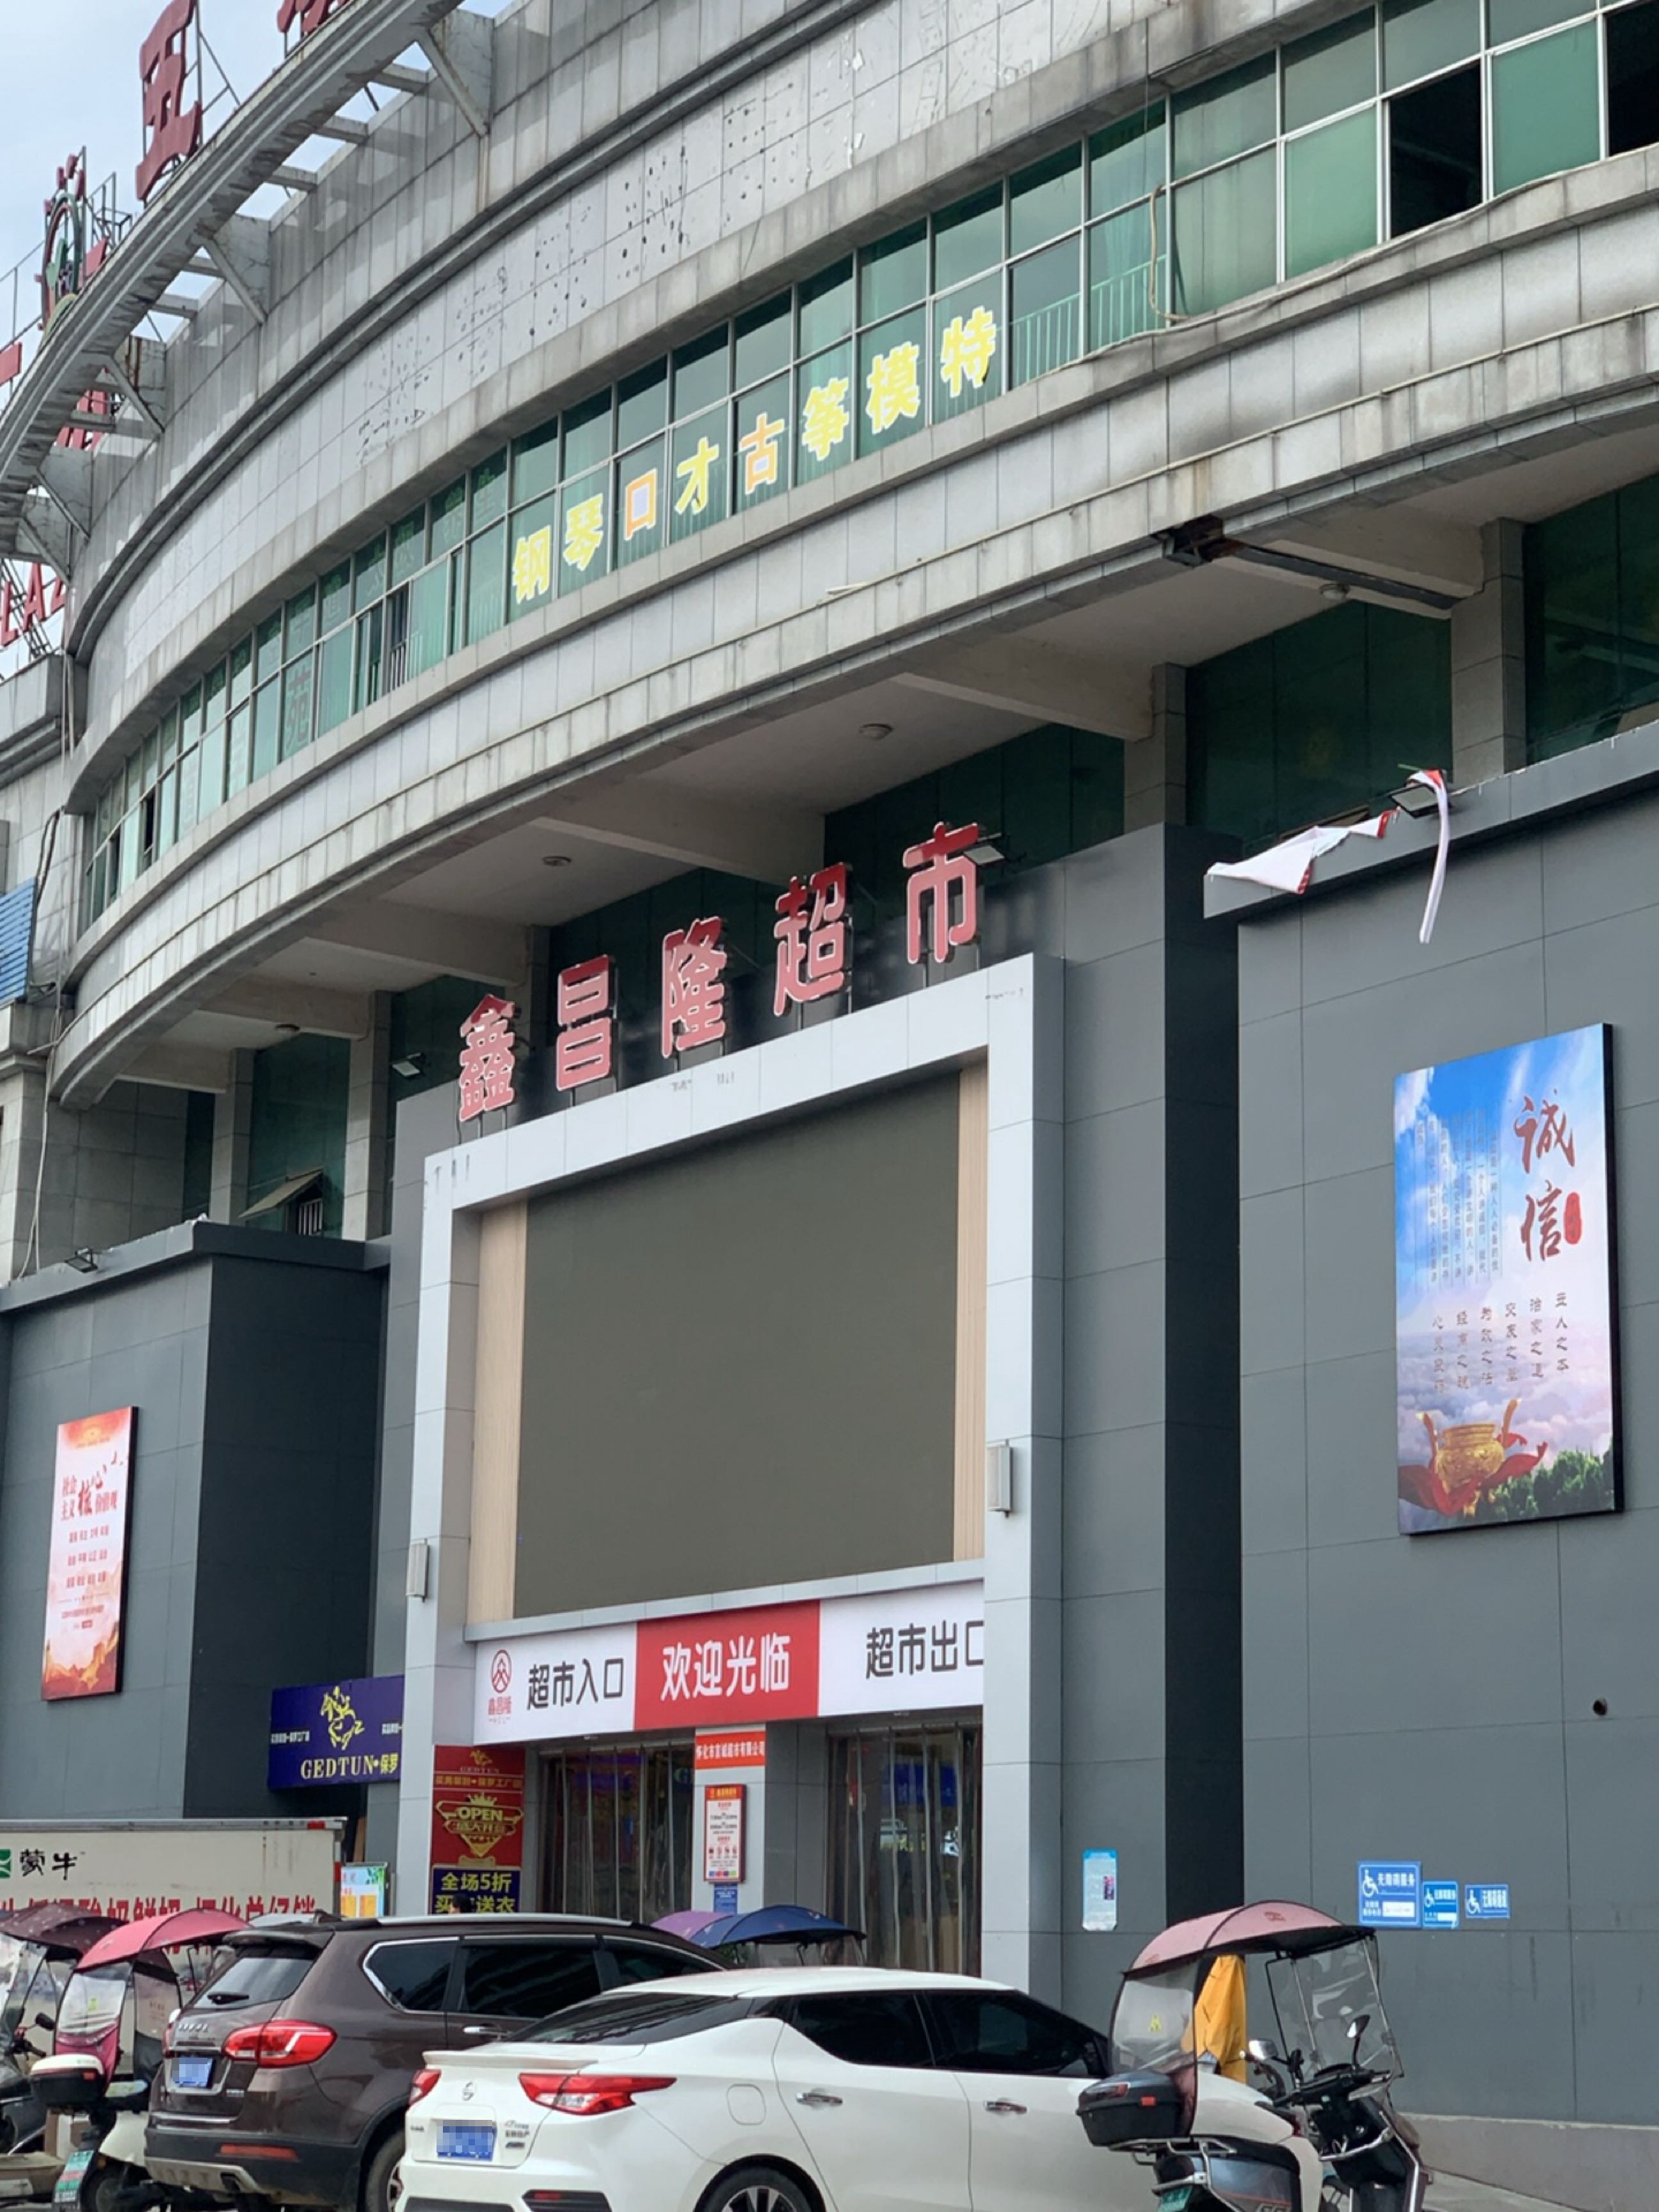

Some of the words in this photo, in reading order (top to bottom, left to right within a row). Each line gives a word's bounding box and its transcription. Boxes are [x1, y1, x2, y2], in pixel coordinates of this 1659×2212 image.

[513, 305, 997, 604] 钢琴口才古筝模特
[459, 821, 981, 1123] 鑫昌隆超市
[1514, 1089, 1576, 1262] 诚信
[660, 1632, 791, 1701] 欢迎光临
[865, 1618, 984, 1679] 超市出口
[527, 1658, 625, 1711] 超市入口
[458, 1806, 503, 1822] OPEN
[20, 1848, 77, 1880] 蒙牛
[440, 1871, 512, 1894] 全场5折
[435, 1895, 516, 1913] 买送衣
